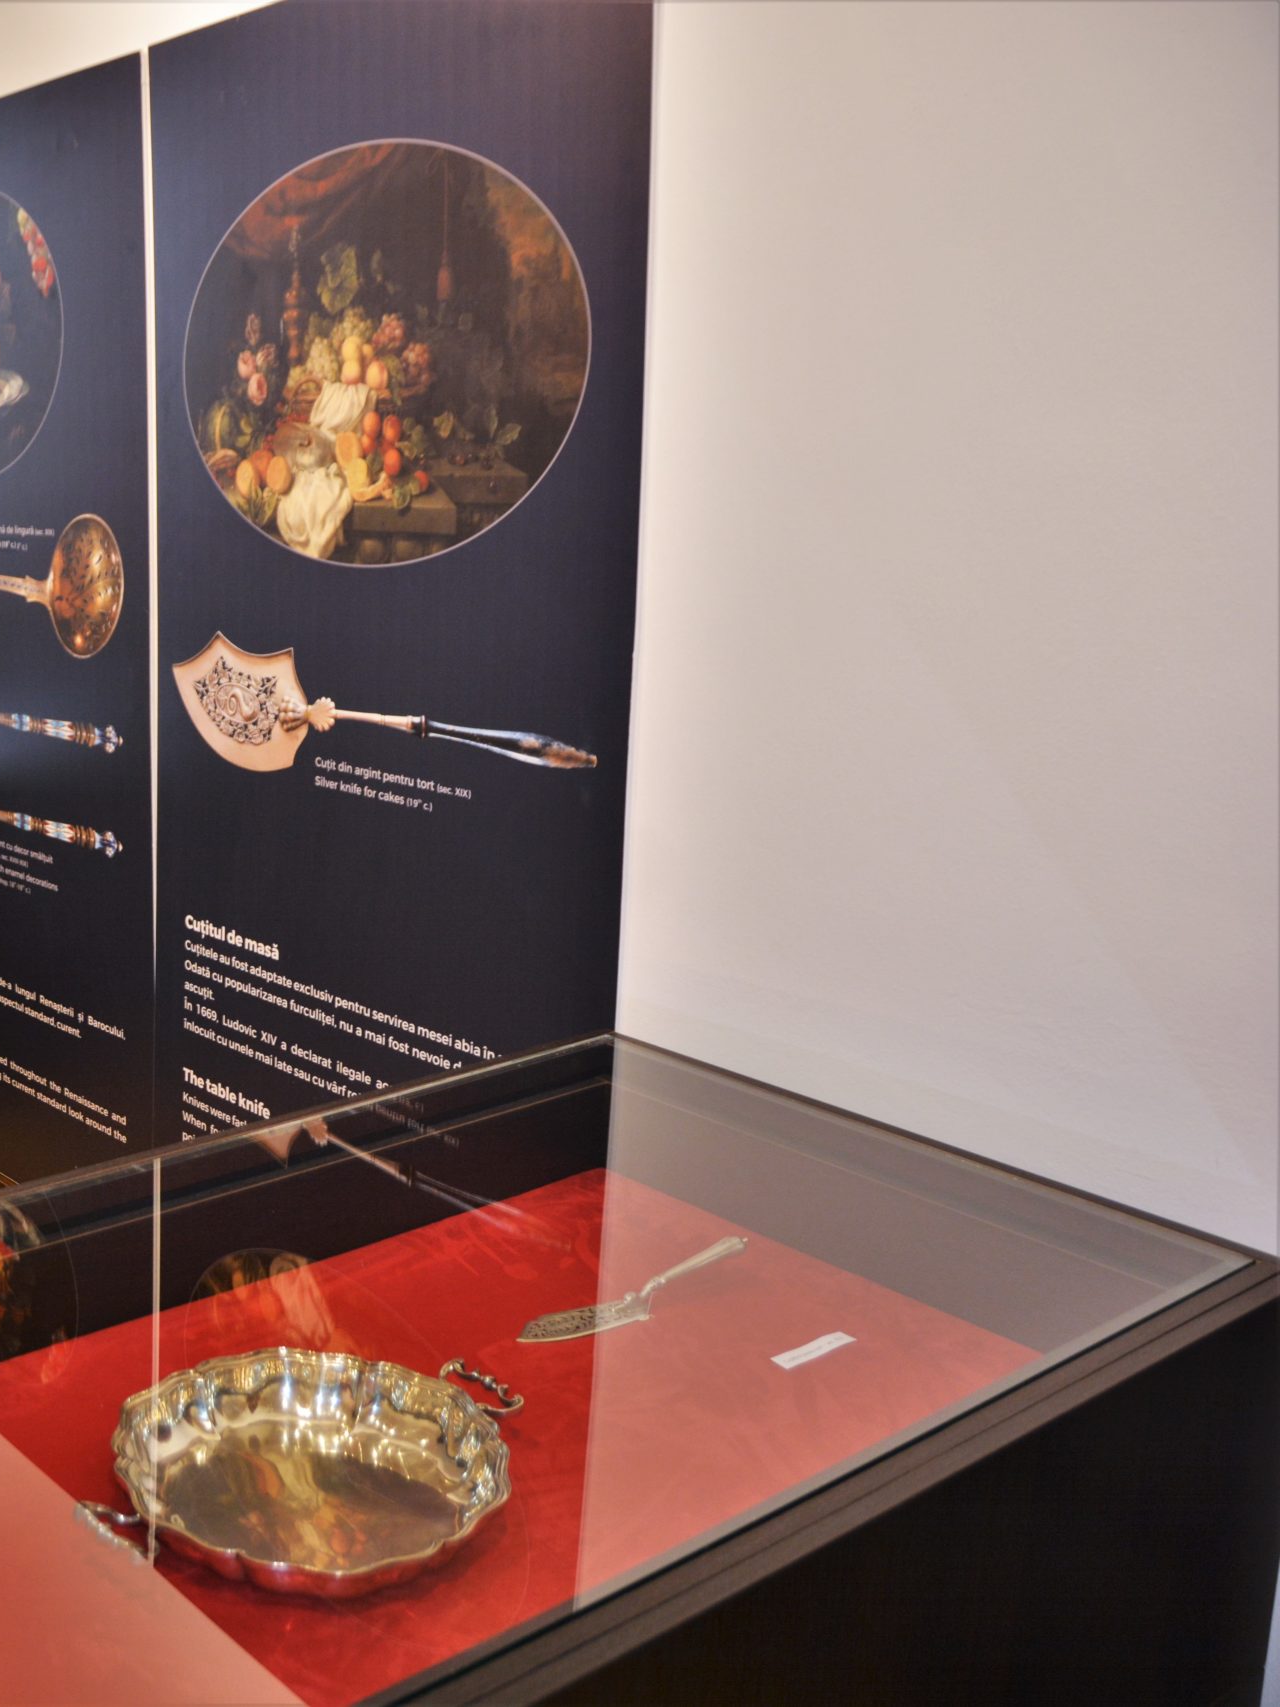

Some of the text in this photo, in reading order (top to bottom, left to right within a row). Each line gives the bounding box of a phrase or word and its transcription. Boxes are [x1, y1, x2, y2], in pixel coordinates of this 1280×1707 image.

[315, 757, 336, 772] Cuțit
[338, 762, 353, 774] din
[354, 766, 382, 780] argint
[383, 772, 414, 787] pentru
[417, 778, 435, 791] tort
[455, 788, 472, 800] XIX)
[315, 776, 338, 790] Silver
[340, 781, 362, 795] knife
[364, 786, 377, 799] for
[378, 791, 405, 805] cakes
[185, 914, 280, 960] Cuțitul de masă
[15, 984, 36, 1001] lungul
[40, 995, 74, 1018] Renașterii
[88, 1016, 126, 1041] Barocului,
[184, 981, 215, 1001] ascuțit.
[184, 960, 211, 979] Odată
[212, 971, 223, 983] cu
[225, 976, 288, 1009] popularizarea
[290, 1000, 337, 1028] furculiței,
[340, 1021, 354, 1034] nu
[356, 1027, 363, 1037] a
[365, 1030, 386, 1046] mai
[388, 1036, 410, 1055] fost
[412, 1047, 450, 1070] nevoie
[185, 940, 219, 961] Cuțitele
[220, 953, 231, 966] au
[232, 956, 249, 972] fost
[250, 965, 292, 989] adaptate
[294, 982, 334, 1004] exclusiv
[335, 996, 370, 1018] pentru
[372, 1010, 415, 1034] servirea
[418, 1026, 453, 1047] mesei
[454, 1038, 481, 1057] abia
[57, 1021, 82, 1039] curent.
[184, 996, 193, 1012] În
[222, 1015, 257, 1038] Ludovic
[260, 1030, 278, 1046] XIV
[281, 1040, 287, 1051] a
[291, 1043, 332, 1070] declarat
[336, 1060, 372, 1085] ilegale
[184, 1018, 216, 1042] înlocuit
[216, 1034, 228, 1046] cu
[229, 1040, 254, 1058] unele
[255, 1051, 273, 1066] mai
[274, 1056, 292, 1074] late
[294, 1067, 311, 1082] sau
[312, 1075, 325, 1088] cu
[326, 1080, 347, 1097] vârf
[3, 1072, 11, 1084] its
[12, 1079, 36, 1097] current
[37, 1092, 67, 1113] standard
[68, 1106, 84, 1122] look
[85, 1117, 112, 1136] around
[114, 1130, 127, 1144] the
[10, 1061, 48, 1086] throughout
[50, 1081, 62, 1093] the
[64, 1088, 109, 1117] Renaissance
[112, 1112, 126, 1126] and
[182, 1091, 209, 1113] Knives
[210, 1106, 231, 1123] were
[183, 1067, 270, 1120] The table knife
[182, 1110, 207, 1132] When
